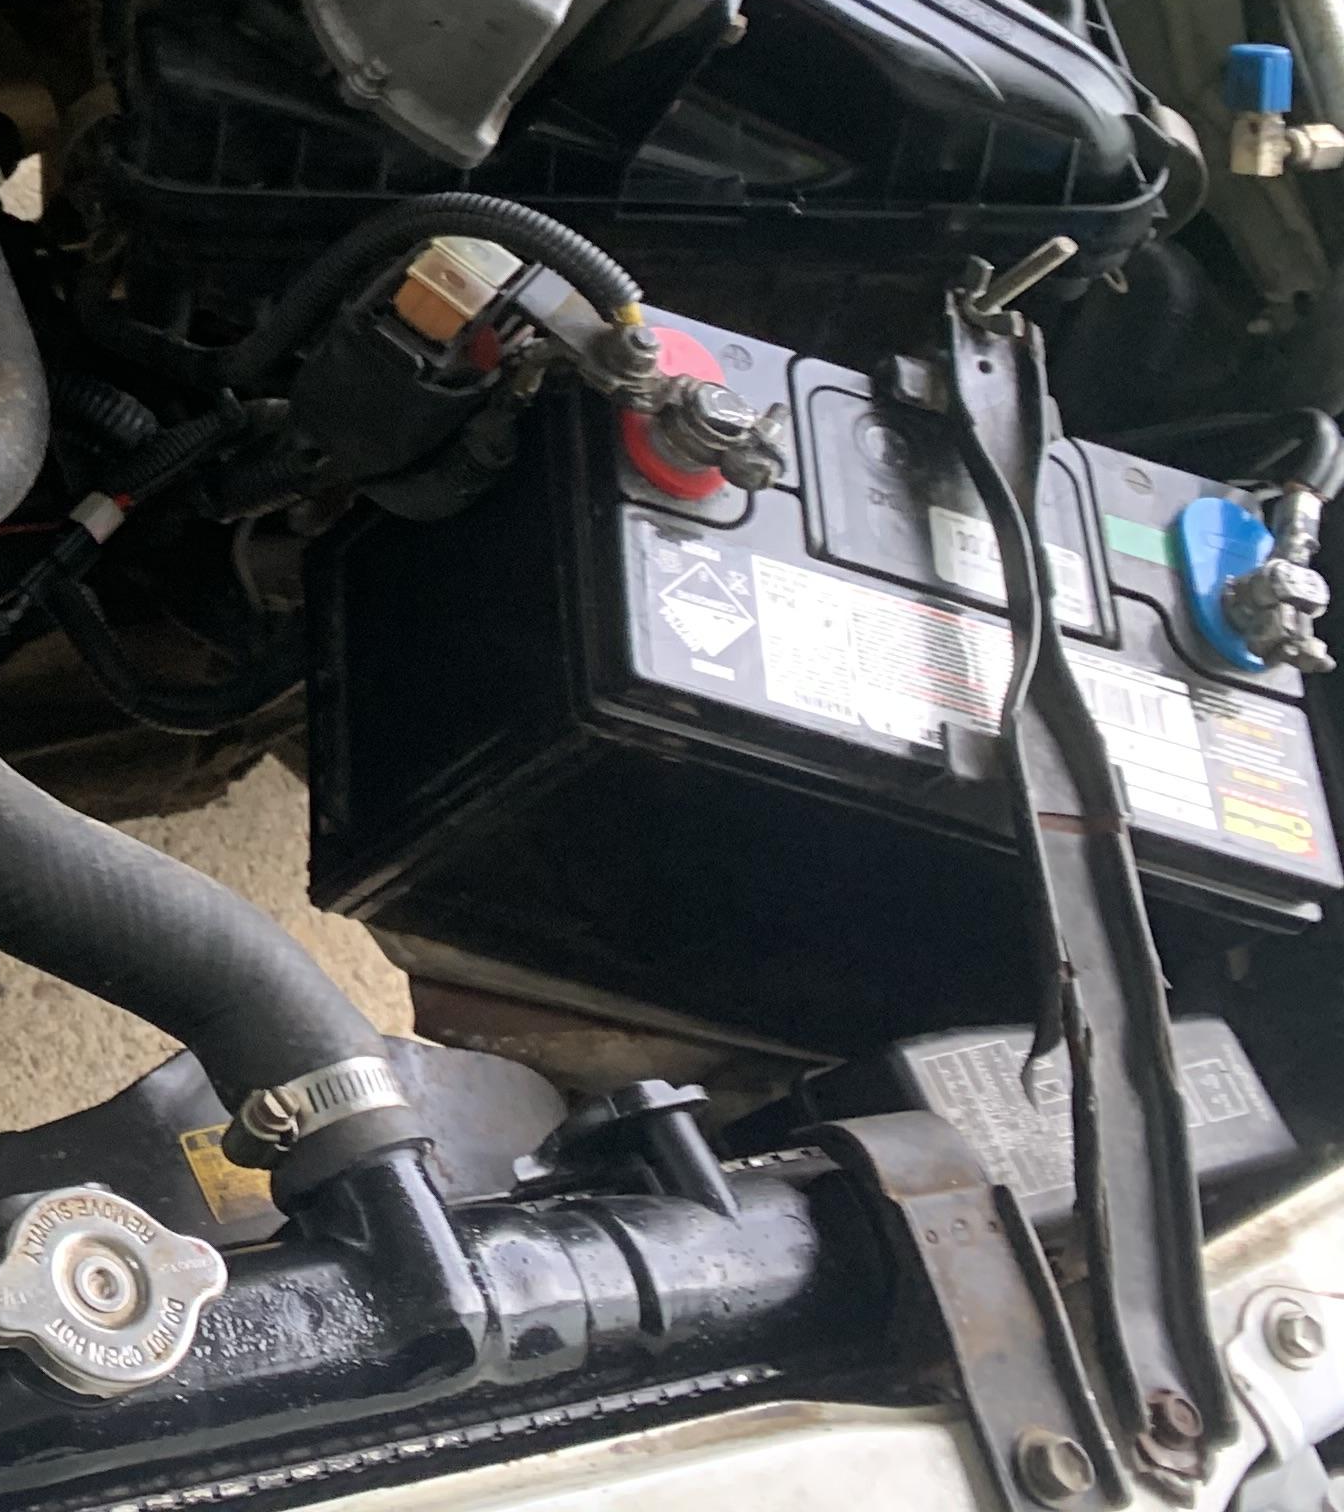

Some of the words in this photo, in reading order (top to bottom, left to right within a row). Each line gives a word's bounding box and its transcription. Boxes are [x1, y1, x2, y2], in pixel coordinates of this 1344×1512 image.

[20, 1201, 73, 1265] SLOWLY
[77, 1197, 156, 1245] REMOVE
[161, 1296, 185, 1325] DO
[45, 1319, 87, 1355] HOT
[88, 1341, 144, 1370] OPEN
[145, 1321, 174, 1362] NOT
